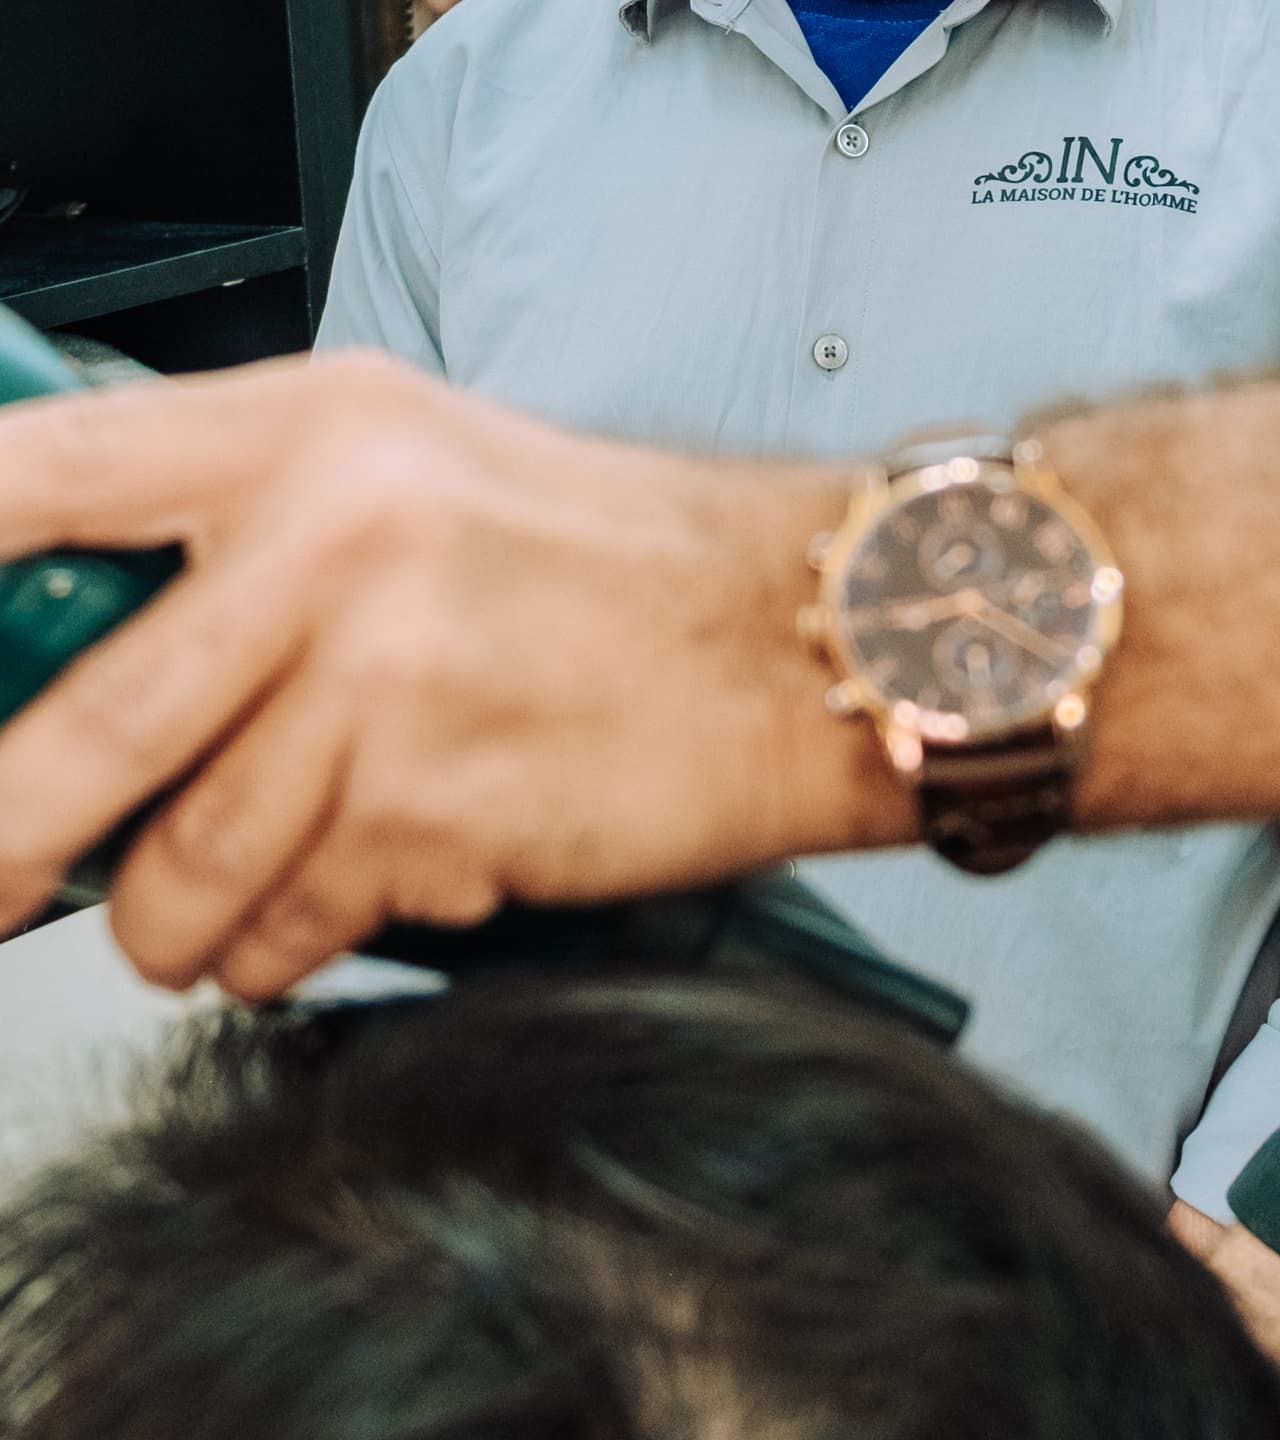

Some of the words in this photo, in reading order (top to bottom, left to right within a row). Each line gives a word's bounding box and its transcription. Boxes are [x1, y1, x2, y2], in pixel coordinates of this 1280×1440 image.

[1056, 136, 1124, 184] IN
[971, 190, 994, 204] LA
[1000, 187, 1075, 202] MAISON
[1080, 189, 1106, 202] DE
[1111, 190, 1198, 214] L'HOMME
